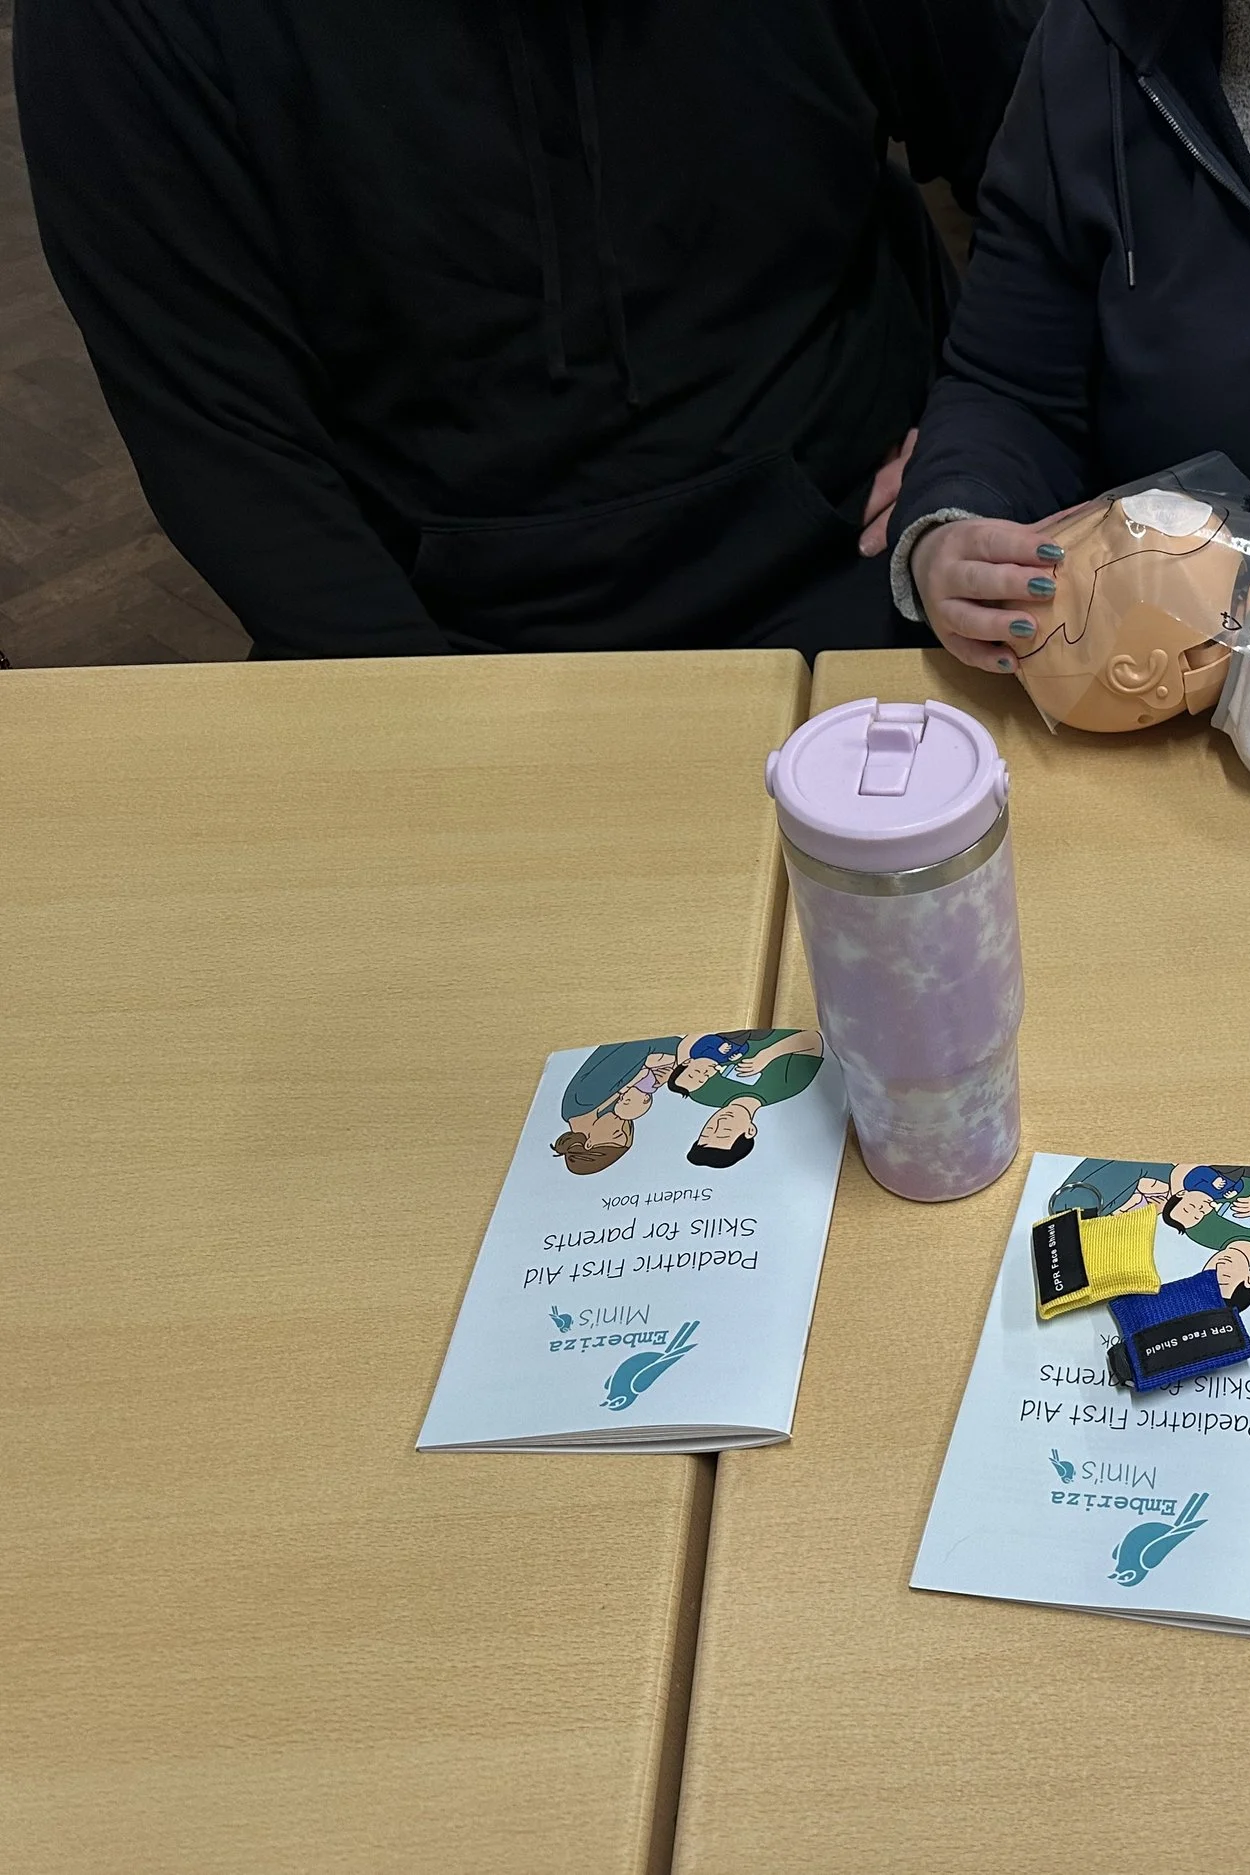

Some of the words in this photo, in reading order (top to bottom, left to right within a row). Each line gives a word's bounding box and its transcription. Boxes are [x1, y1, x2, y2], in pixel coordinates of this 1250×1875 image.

[601, 1194, 639, 1210] book
[644, 1188, 712, 1206] Student
[543, 1218, 636, 1253] parents
[643, 1221, 679, 1242] for
[691, 1217, 758, 1240] Skills
[1048, 1224, 1056, 1248] Shield
[570, 1258, 625, 1281] First
[634, 1249, 758, 1273] Paediatric
[1051, 1249, 1061, 1269] Face
[523, 1265, 563, 1288] Aid
[1053, 1271, 1064, 1291] CPR
[579, 1304, 650, 1329] Mini's
[1182, 1330, 1207, 1341] Face
[1210, 1325, 1233, 1334] CPR
[549, 1330, 669, 1354] Emberiza
[1100, 1334, 1124, 1350] ok
[1145, 1338, 1178, 1356] Shield
[1021, 1399, 1061, 1424] Aid
[1069, 1405, 1128, 1430] First
[1081, 1461, 1157, 1489] Mini's
[1050, 1491, 1177, 1516] Emberiza
